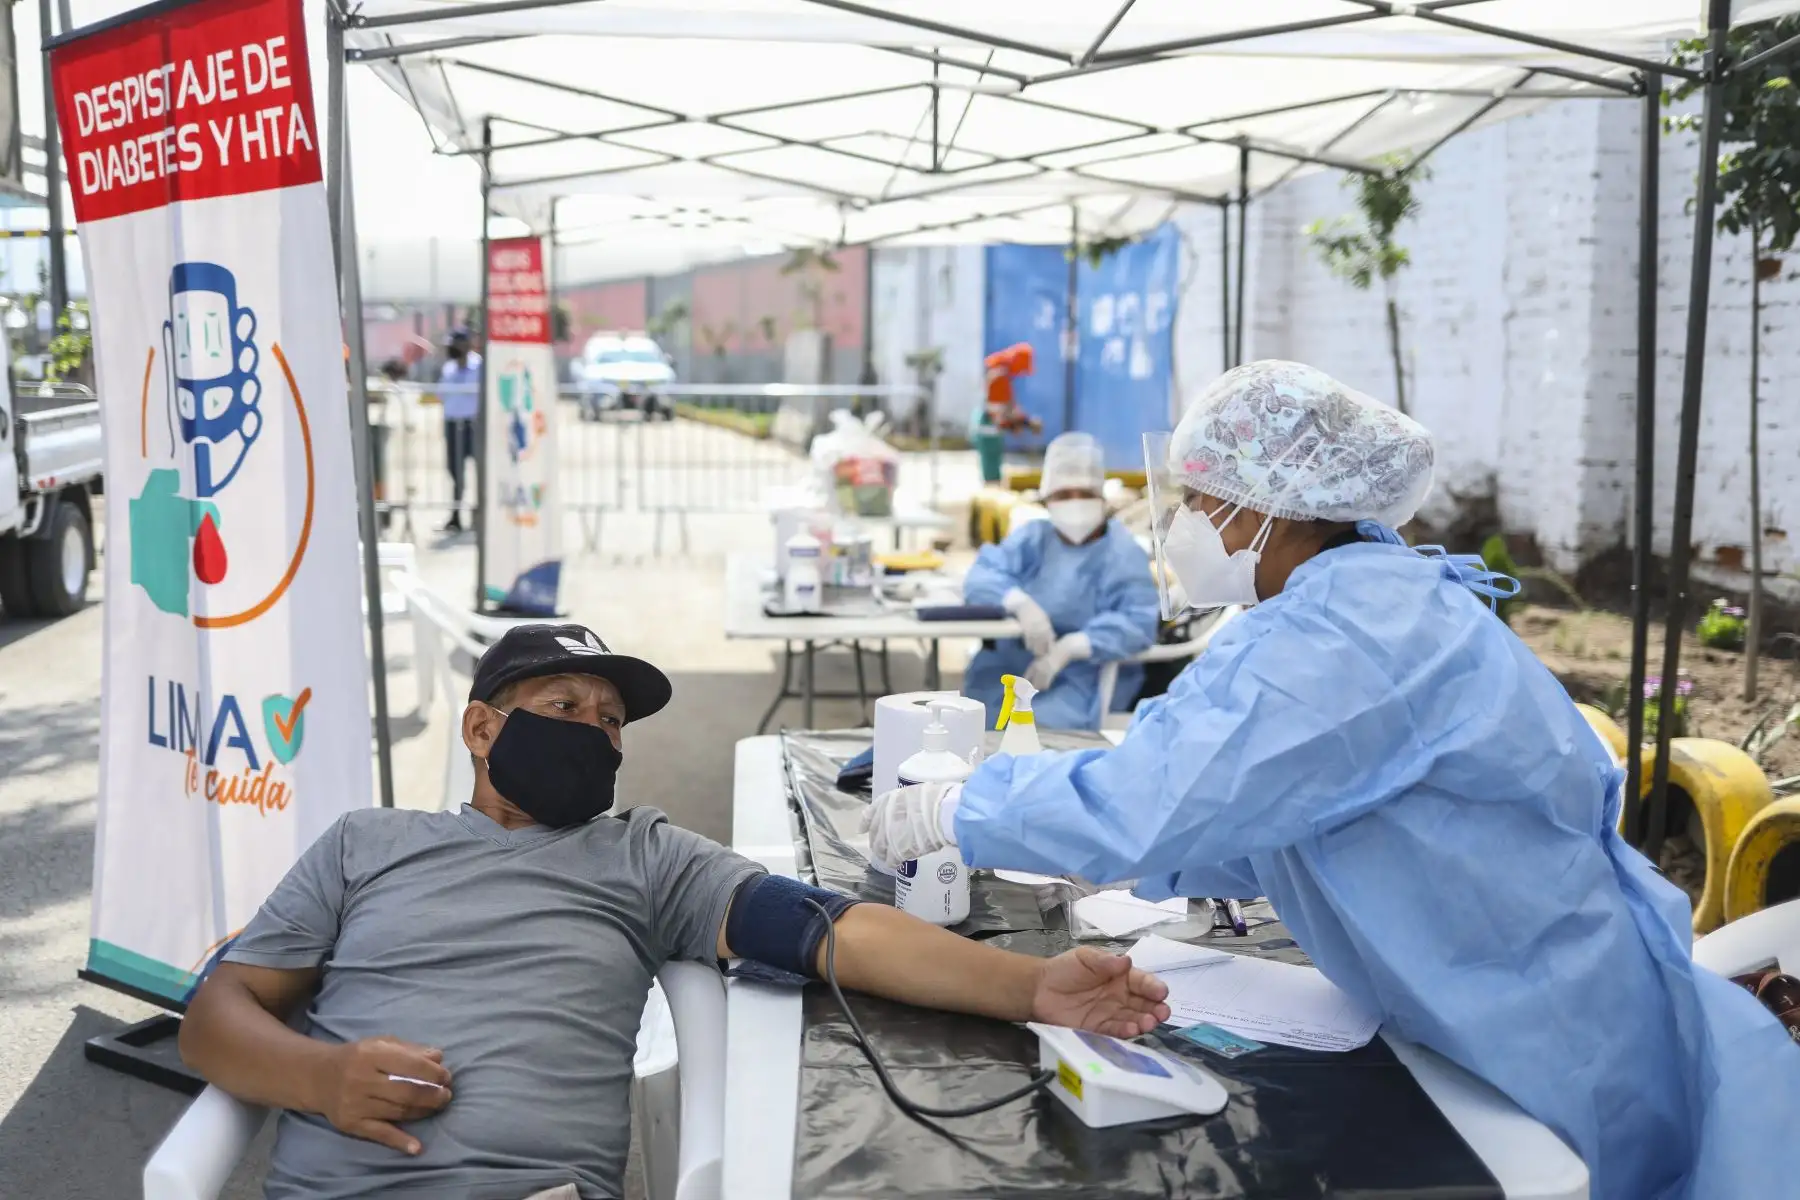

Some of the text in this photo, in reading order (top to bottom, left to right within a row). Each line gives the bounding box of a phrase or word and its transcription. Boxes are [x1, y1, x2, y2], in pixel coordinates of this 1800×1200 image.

[73, 35, 292, 138] DESPISTAJE DE
[77, 122, 204, 196] DIABETES
[148, 675, 261, 771] LIMA
[204, 760, 292, 818] cuida
